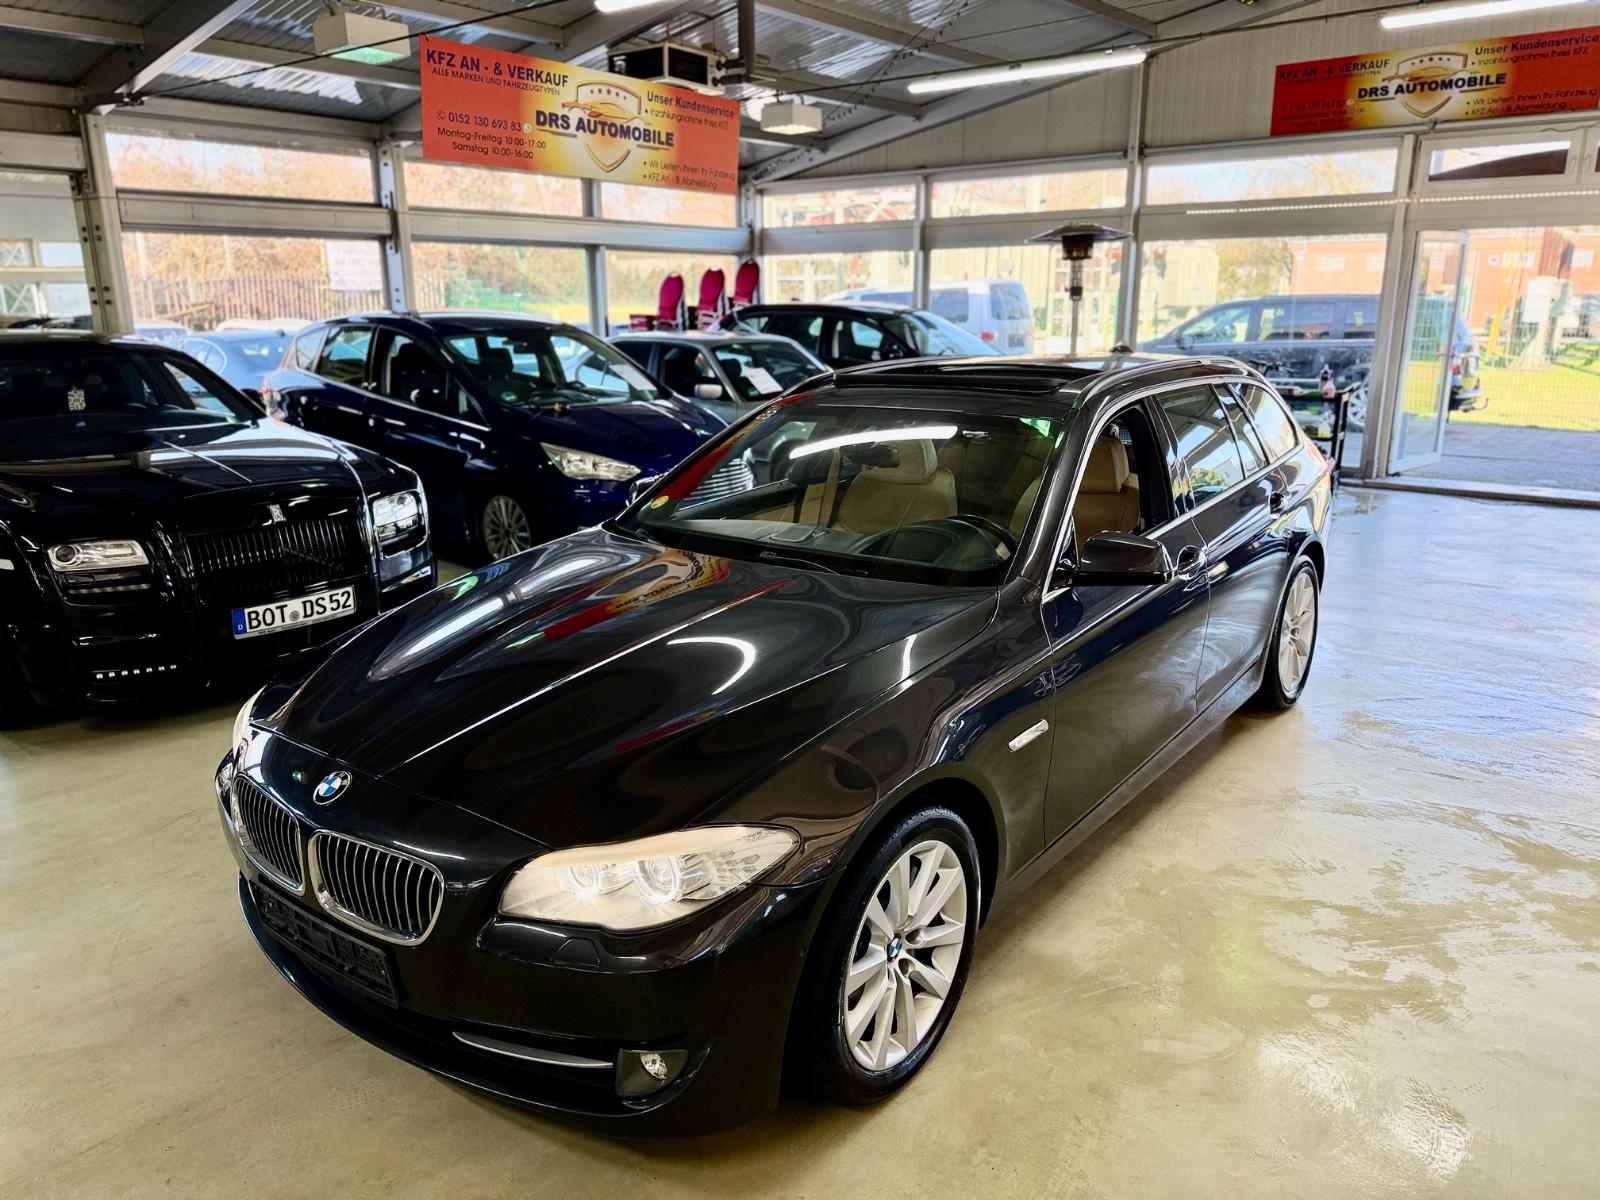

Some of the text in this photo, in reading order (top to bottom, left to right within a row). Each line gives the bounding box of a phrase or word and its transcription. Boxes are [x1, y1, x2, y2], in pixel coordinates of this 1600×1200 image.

[1475, 34, 1600, 55] Unser Kundenservice
[426, 49, 456, 68] KFZ
[460, 56, 480, 72] AN
[493, 62, 503, 76] &
[507, 64, 569, 87] VERKAUF
[1338, 58, 1391, 73] VERKAUF
[432, 67, 560, 96] ALLE MARKEN UND FAHRZEUGTYPEN
[1357, 86, 1389, 99] DRS
[1394, 73, 1507, 95] AUTOMOBILE
[647, 90, 735, 119] Unser Kundenservice
[448, 112, 521, 132] 0152 130 693 83
[535, 110, 674, 147] DRS AUTOMOBILE
[437, 127, 503, 145] Montag-Freitag
[452, 141, 489, 155] Samstag
[247, 604, 288, 630] BOT
[302, 597, 327, 619] DS
[329, 591, 352, 612] 52
